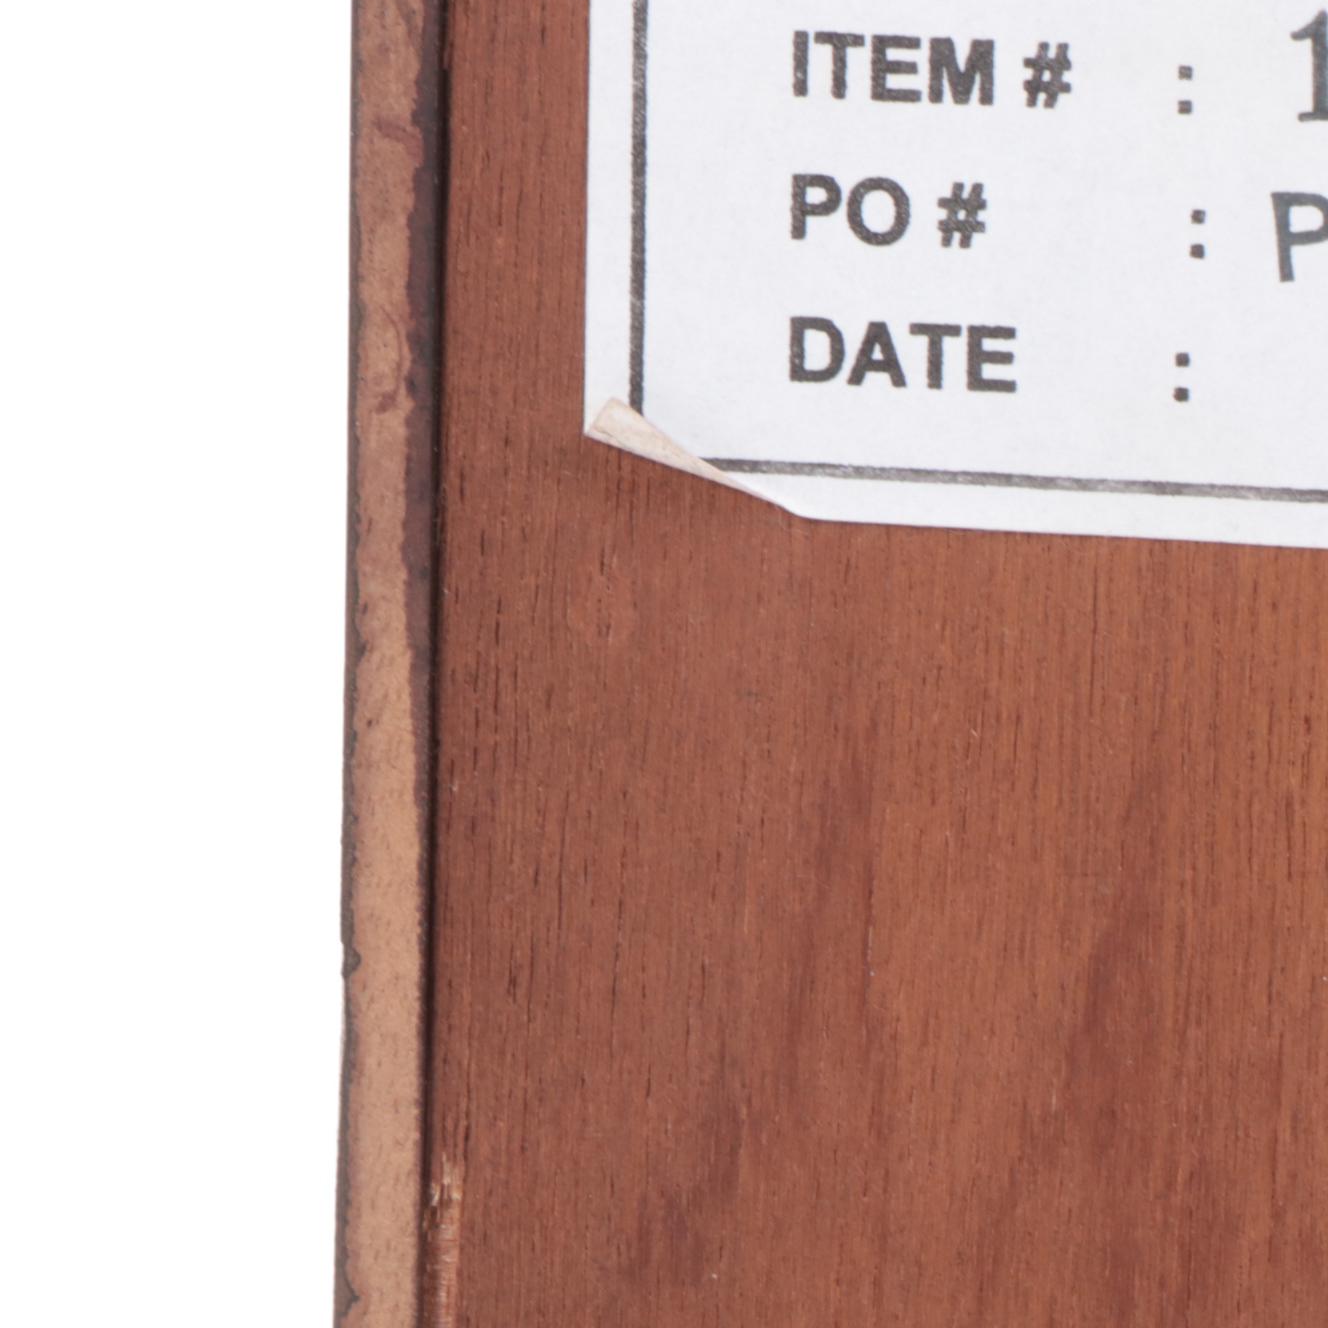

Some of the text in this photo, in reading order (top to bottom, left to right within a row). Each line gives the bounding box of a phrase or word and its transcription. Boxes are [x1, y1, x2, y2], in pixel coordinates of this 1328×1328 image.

[793, 30, 995, 106] ITEM
[1023, 42, 1072, 109] #
[790, 173, 911, 247] PO
[937, 182, 987, 249] #
[789, 316, 1017, 393] DATE
